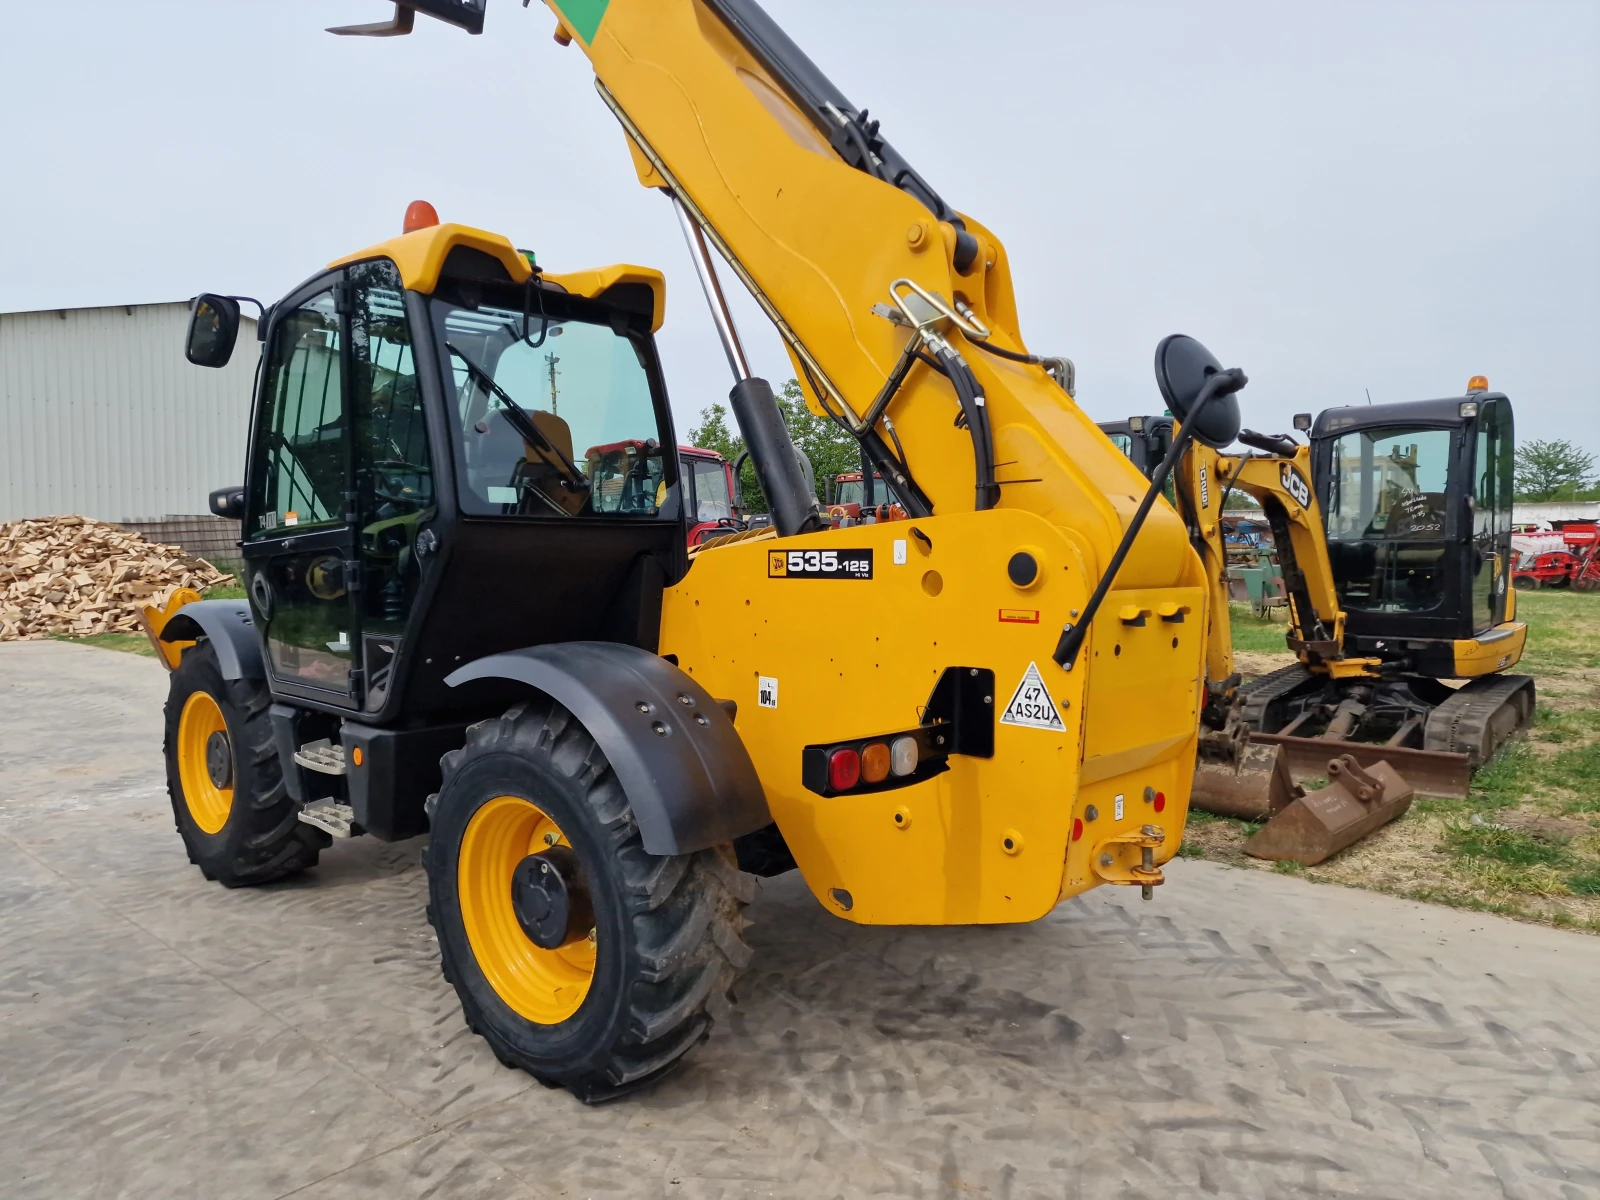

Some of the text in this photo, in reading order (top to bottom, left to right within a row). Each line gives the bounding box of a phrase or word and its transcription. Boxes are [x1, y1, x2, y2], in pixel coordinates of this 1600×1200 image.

[1282, 463, 1309, 507] JCB
[1410, 523, 1441, 532] 2052
[760, 690, 771, 705] 104
[1024, 687, 1041, 702] 47
[1015, 702, 1050, 721] AS2U
